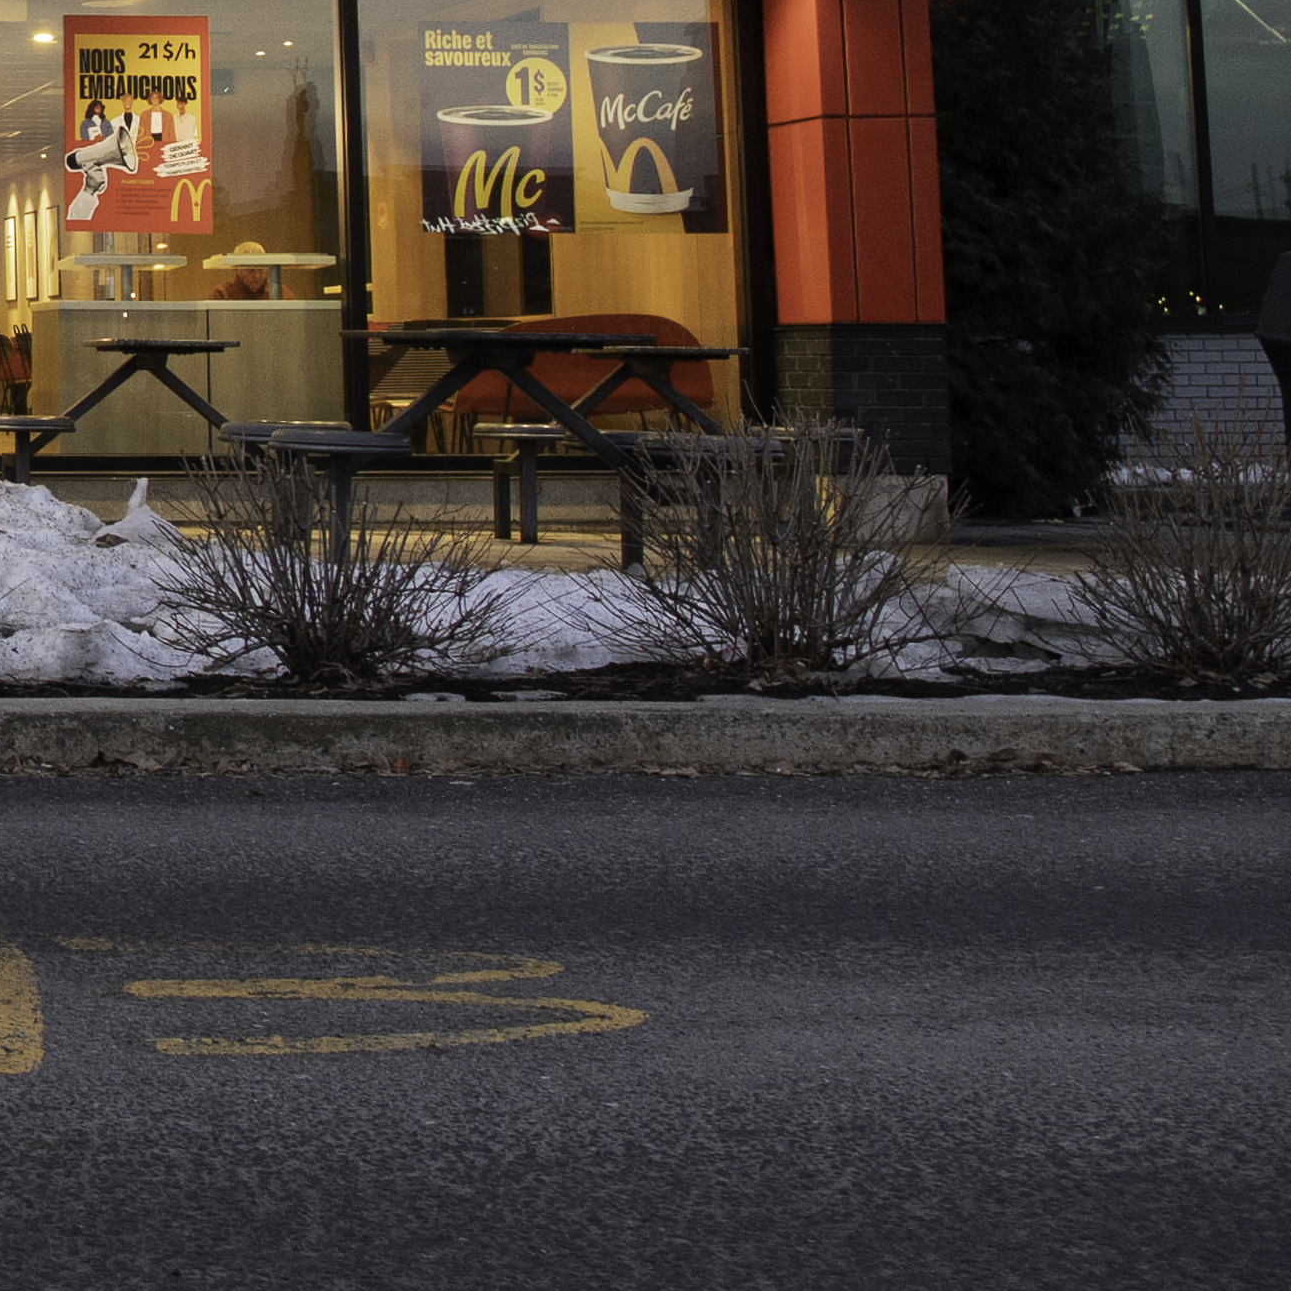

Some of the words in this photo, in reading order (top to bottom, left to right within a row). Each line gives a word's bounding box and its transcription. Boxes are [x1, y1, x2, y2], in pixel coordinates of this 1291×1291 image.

[138, 42, 160, 60] 21
[424, 28, 473, 50] Riche
[475, 31, 494, 50] et
[78, 48, 126, 75] NOUS
[424, 50, 512, 67] savoureux
[78, 75, 198, 101] EMBAUCHONS
[600, 87, 695, 131] McCafé
[453, 146, 546, 220] Mc
